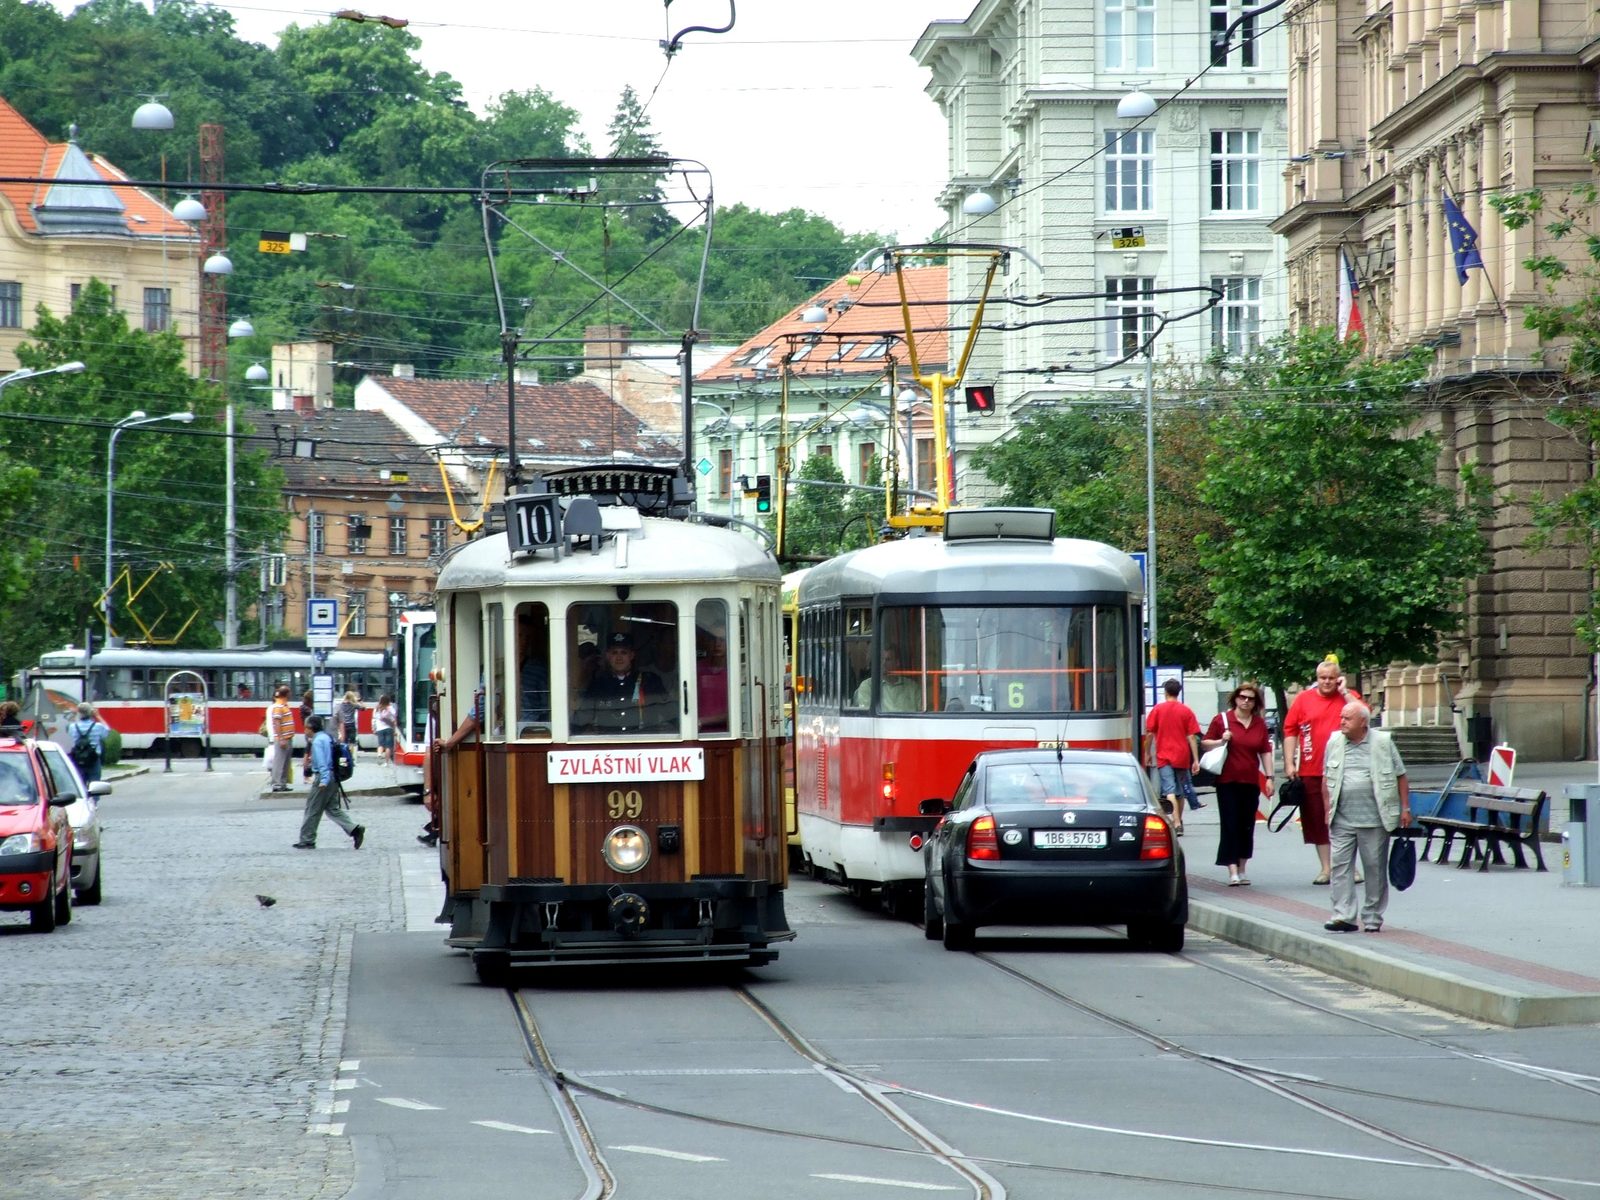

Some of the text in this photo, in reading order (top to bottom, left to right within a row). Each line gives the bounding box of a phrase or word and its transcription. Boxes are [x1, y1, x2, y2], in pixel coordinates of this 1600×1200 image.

[266, 242, 285, 252] 325
[1119, 239, 1140, 248] 326
[516, 504, 552, 546] 10
[1008, 681, 1025, 709] 6
[560, 753, 692, 776] ZVLÁŠTNÍ VLAK
[607, 789, 643, 819] 99
[1045, 831, 1101, 845] 1B6 5763
